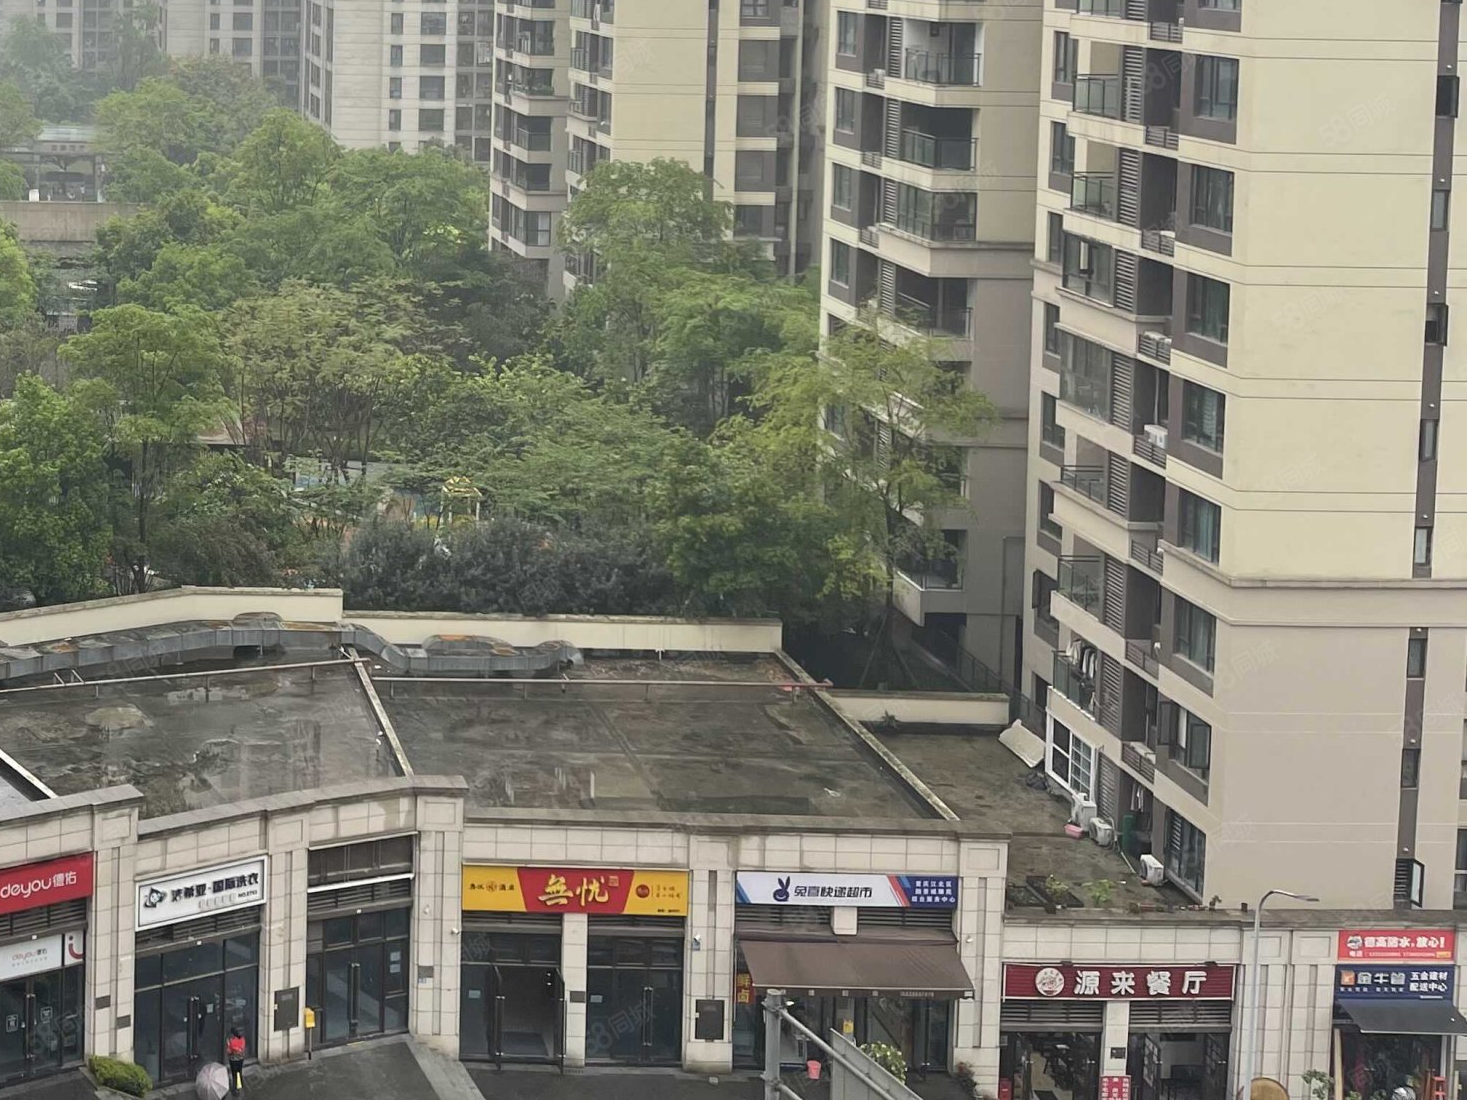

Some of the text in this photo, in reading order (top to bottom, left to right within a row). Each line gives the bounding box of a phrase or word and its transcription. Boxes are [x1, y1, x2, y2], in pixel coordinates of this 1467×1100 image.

[1410, 971, 1448, 981] 五金建材
[1073, 970, 1208, 996] 源来餐厅
[1409, 982, 1448, 992] 配送中心
